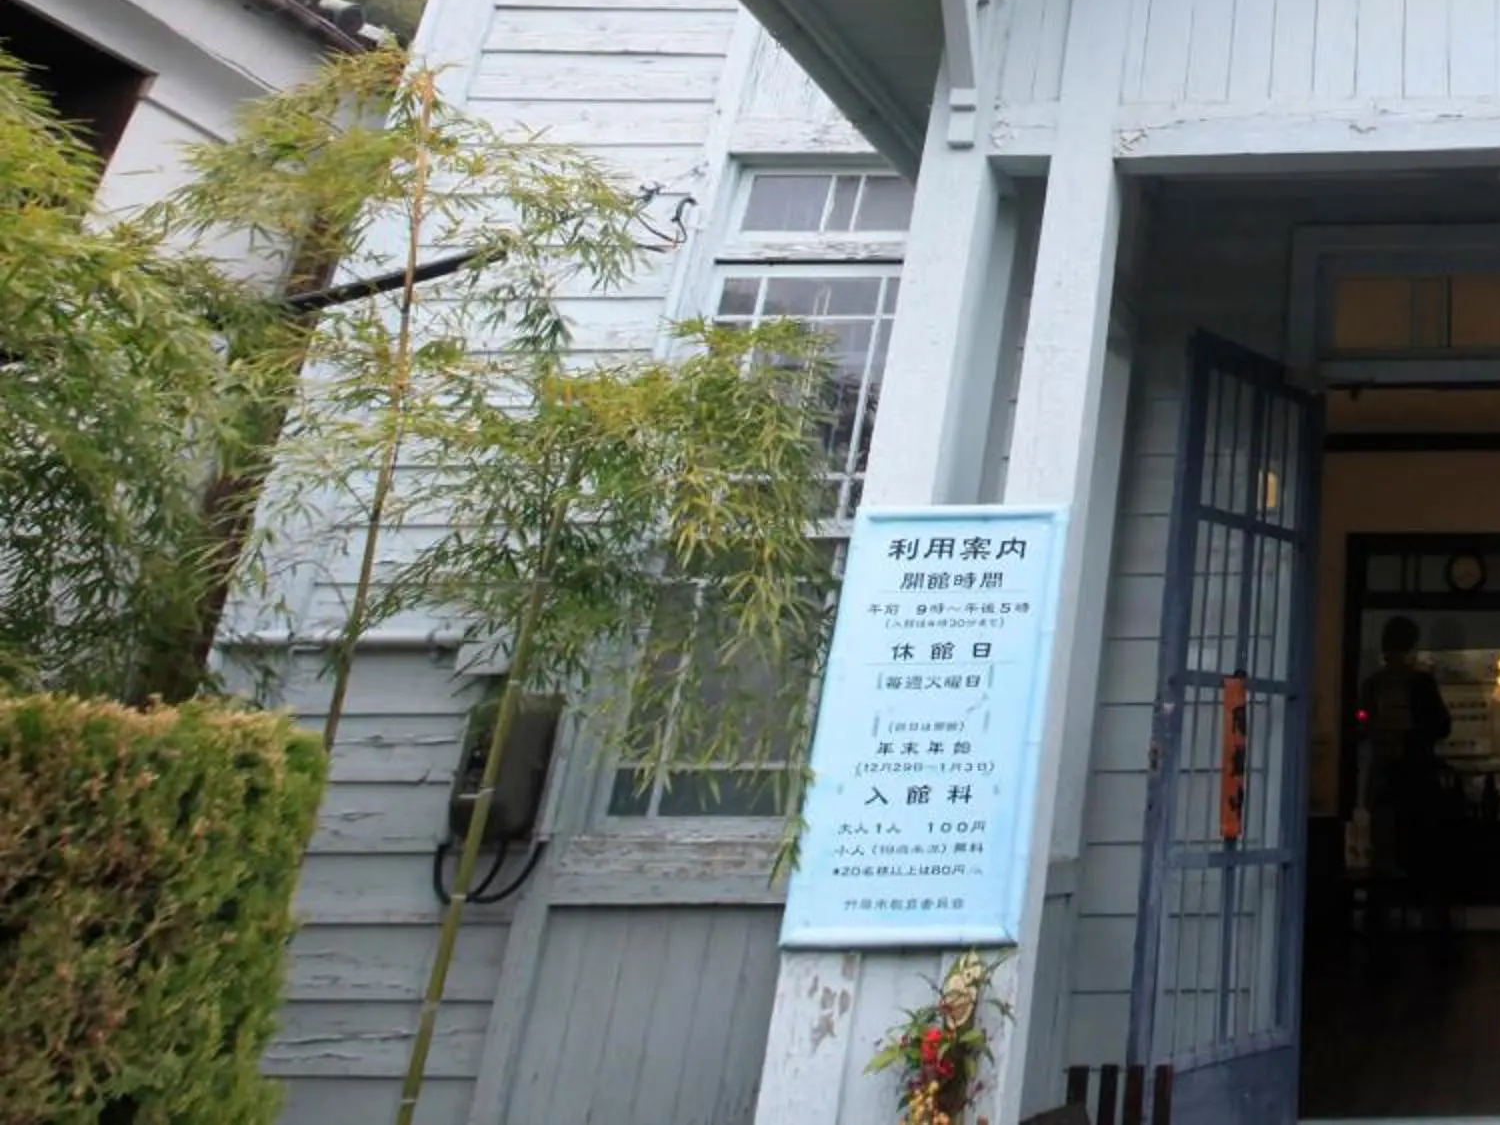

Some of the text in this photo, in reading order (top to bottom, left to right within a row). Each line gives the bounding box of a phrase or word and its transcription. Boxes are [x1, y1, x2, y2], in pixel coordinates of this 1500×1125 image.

[887, 536, 1028, 561] 利用案内
[899, 571, 1004, 590] 開館時間
[891, 641, 993, 662] 休館日
[863, 783, 974, 805] 入館料
[927, 820, 987, 835] 100円
